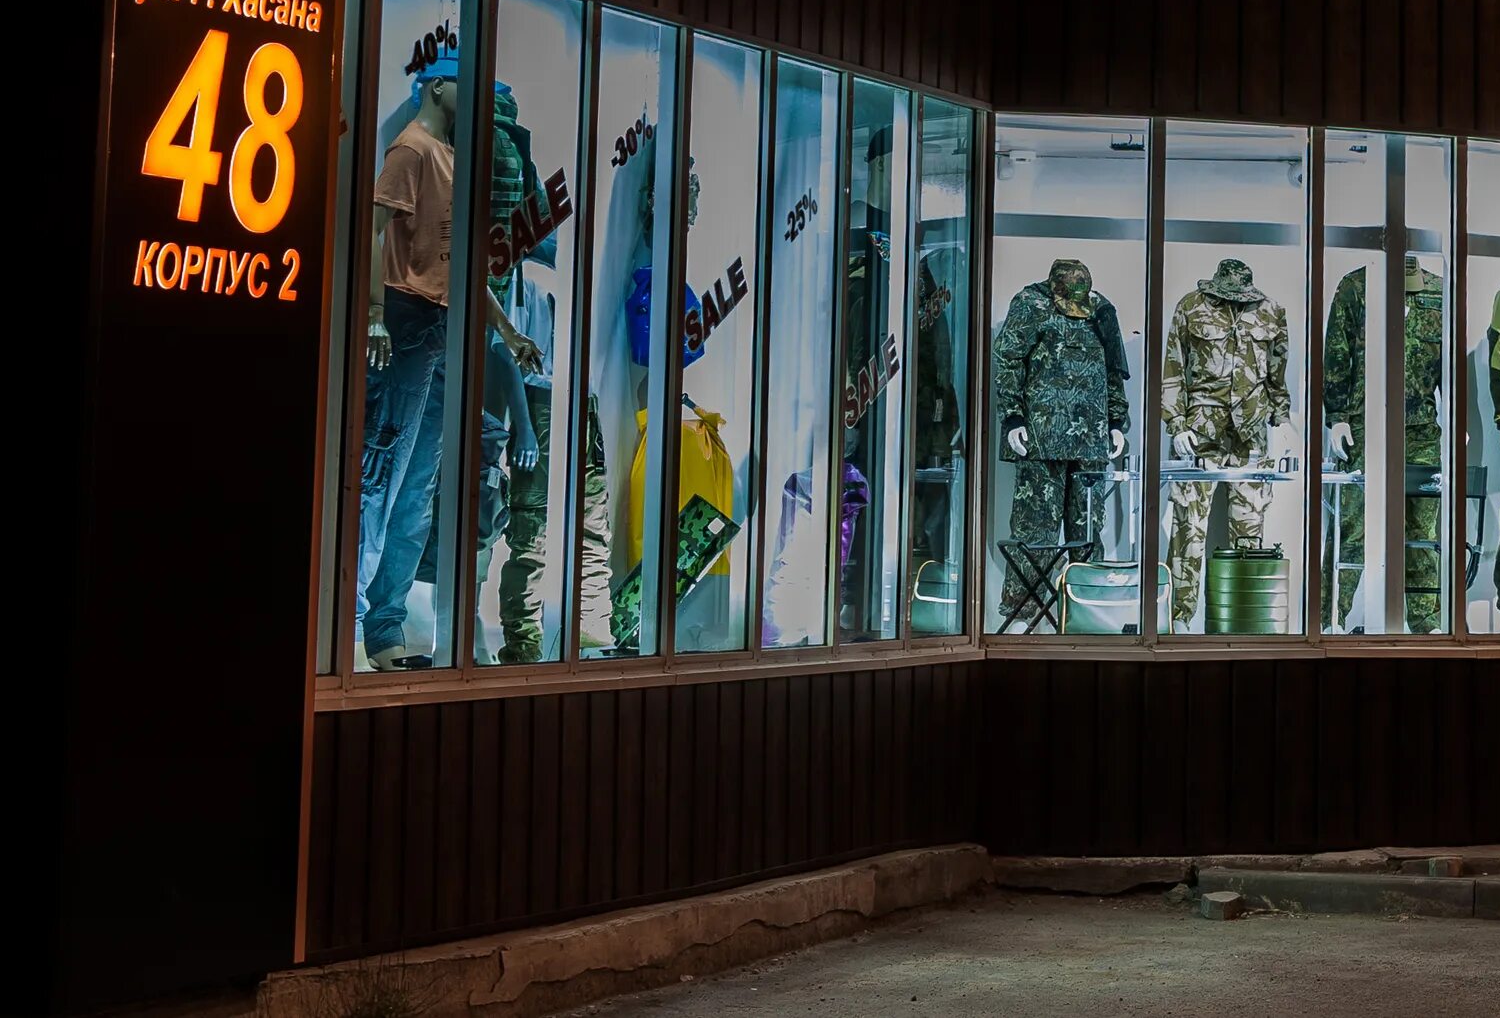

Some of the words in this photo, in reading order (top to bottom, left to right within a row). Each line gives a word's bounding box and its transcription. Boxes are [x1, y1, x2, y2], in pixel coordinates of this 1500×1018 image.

[404, 19, 458, 76] -40%
[141, 29, 304, 234] 48
[611, 113, 653, 168] -30%
[488, 167, 573, 278] SALE
[784, 187, 818, 243] -25%
[133, 240, 270, 298] КОРПУС
[278, 248, 301, 301] 2
[684, 257, 748, 351] SALE
[845, 333, 900, 429] SALE
